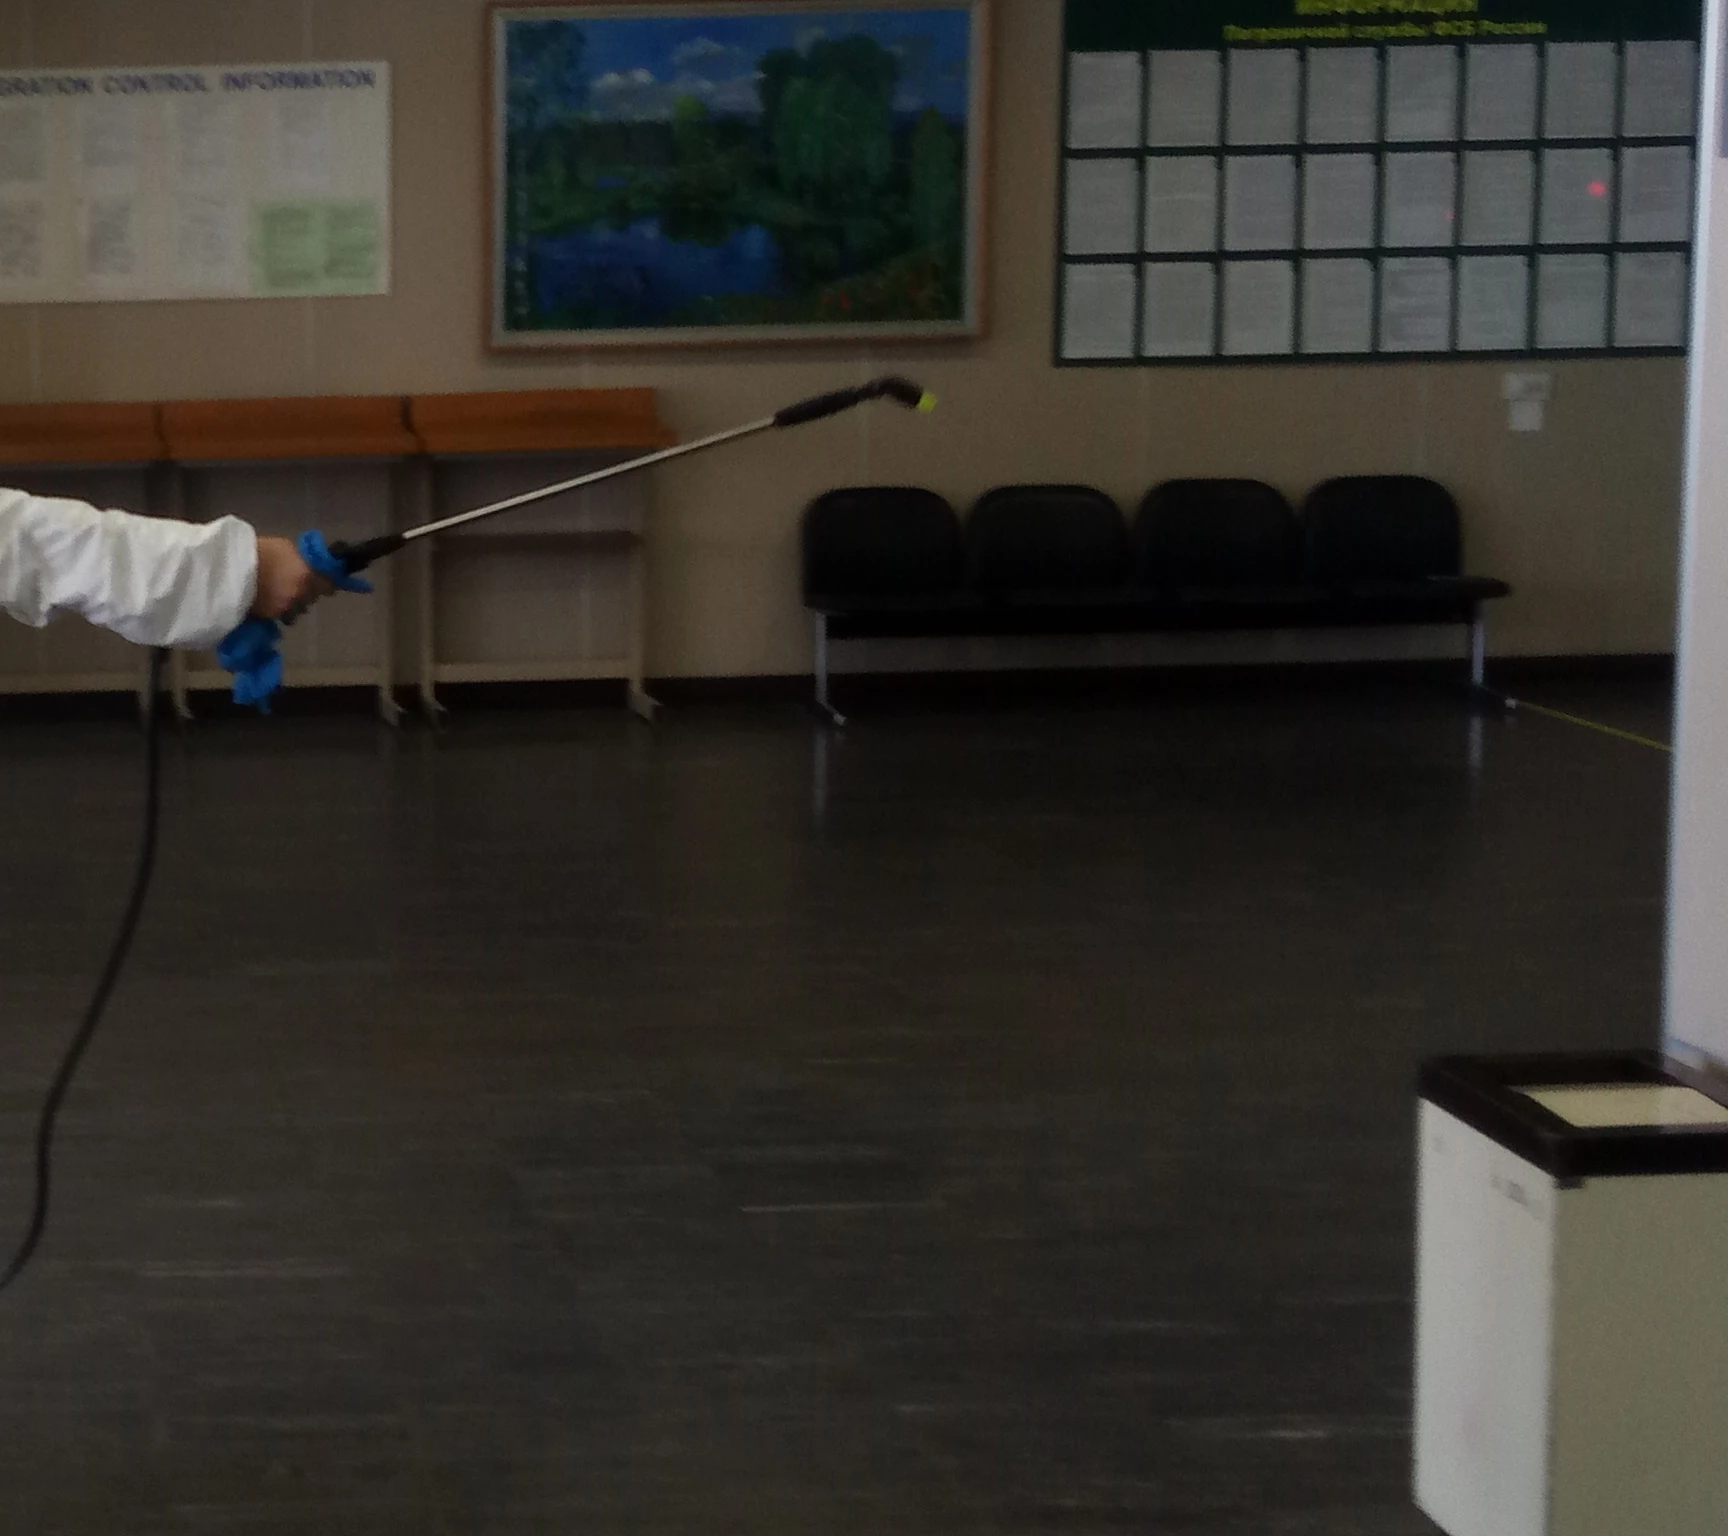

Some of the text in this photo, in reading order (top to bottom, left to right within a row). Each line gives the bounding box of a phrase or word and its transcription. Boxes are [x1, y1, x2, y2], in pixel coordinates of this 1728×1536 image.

[1432, 19, 1477, 38] ФСБ
[1478, 19, 1548, 38] России
[101, 72, 209, 96] CONTROL
[222, 67, 377, 91] INFORMATION
